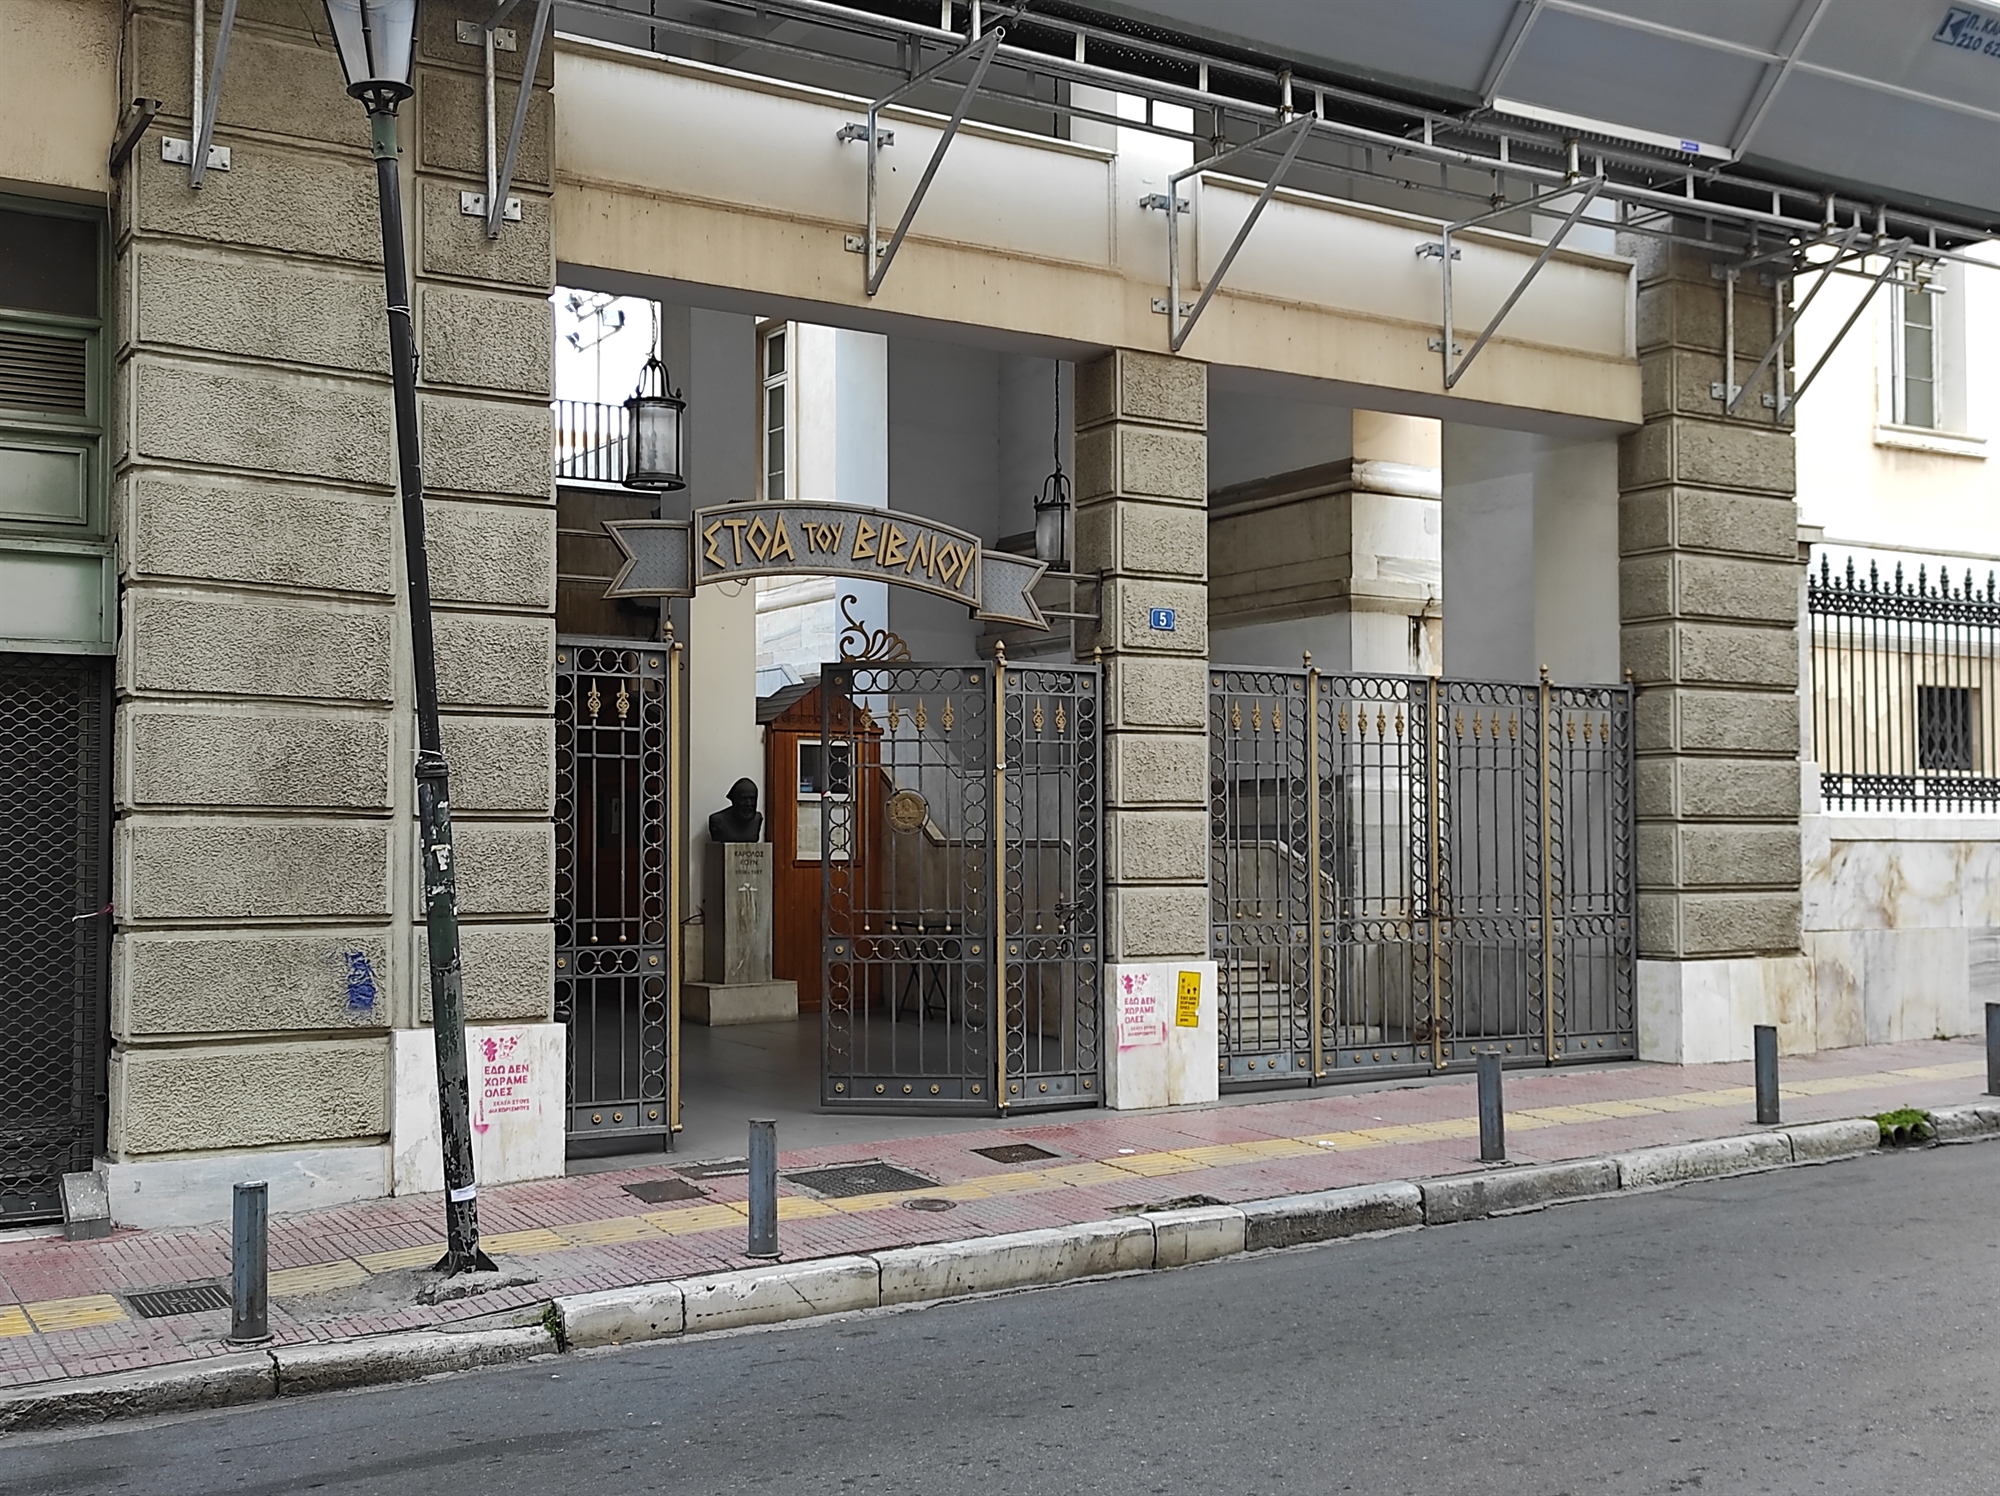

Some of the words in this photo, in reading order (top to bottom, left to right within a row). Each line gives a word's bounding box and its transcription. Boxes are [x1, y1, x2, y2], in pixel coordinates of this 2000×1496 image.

[1981, 18, 2000, 35] ΚΑ
[1956, 33, 1983, 51] 210
[1983, 40, 2000, 57] 62
[703, 513, 795, 568] ΣΤΟΑ
[802, 522, 844, 553] ΤΟΥ
[852, 516, 976, 590] ΒΙΒΛΙΟΥ
[1159, 612, 1167, 626] 5
[1124, 997, 1139, 1005] ΕΔΩ
[1141, 997, 1156, 1005] ΔΕΝ
[1124, 1006, 1155, 1015] ΧΩΡΑΜΕ
[1125, 1016, 1144, 1024] ΟΛΕΣ
[484, 1065, 506, 1075] ΕΔΩ
[508, 1064, 529, 1074] ΔΕΝ
[484, 1075, 528, 1087] ΧΩΡΑΜΕ
[484, 1087, 513, 1098] ΟΛΕΣ
